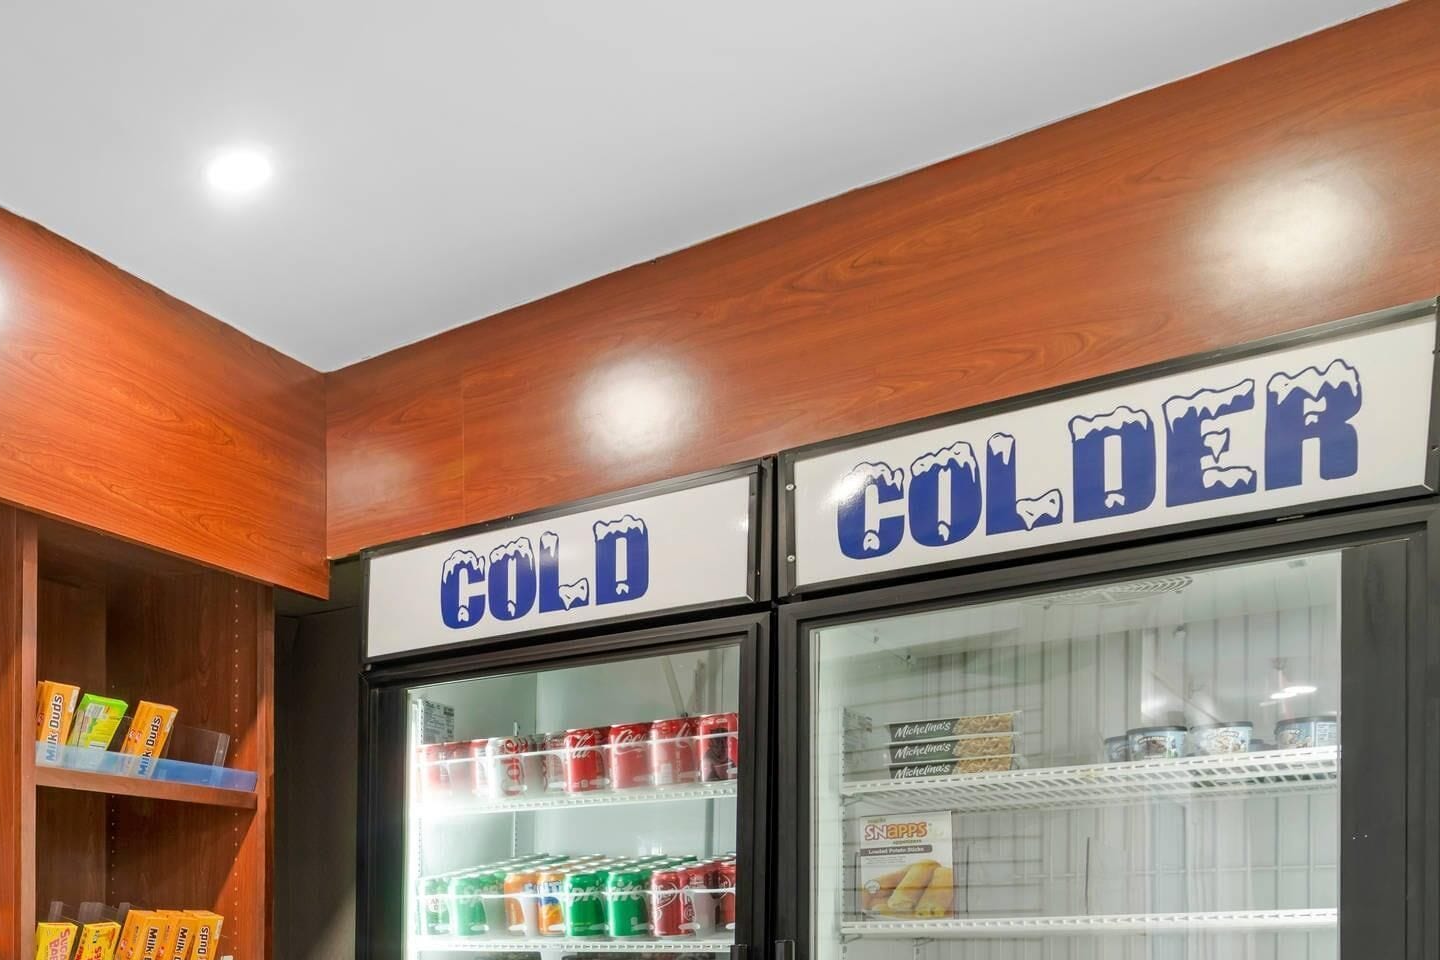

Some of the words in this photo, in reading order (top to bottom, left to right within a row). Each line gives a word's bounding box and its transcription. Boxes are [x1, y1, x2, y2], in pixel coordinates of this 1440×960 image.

[837, 358, 1363, 560] COLDER
[440, 513, 649, 631] COLD
[49, 693, 64, 729] Duds
[137, 750, 152, 776] Milk
[145, 714, 163, 747] Duds
[895, 722, 951, 739] Michelina's
[45, 732, 61, 762] Milk
[895, 743, 951, 760] Michelina's
[894, 764, 950, 779] Michelina's
[145, 926, 159, 955] Milk
[174, 926, 189, 955] Milk
[197, 926, 210, 955] Duds
